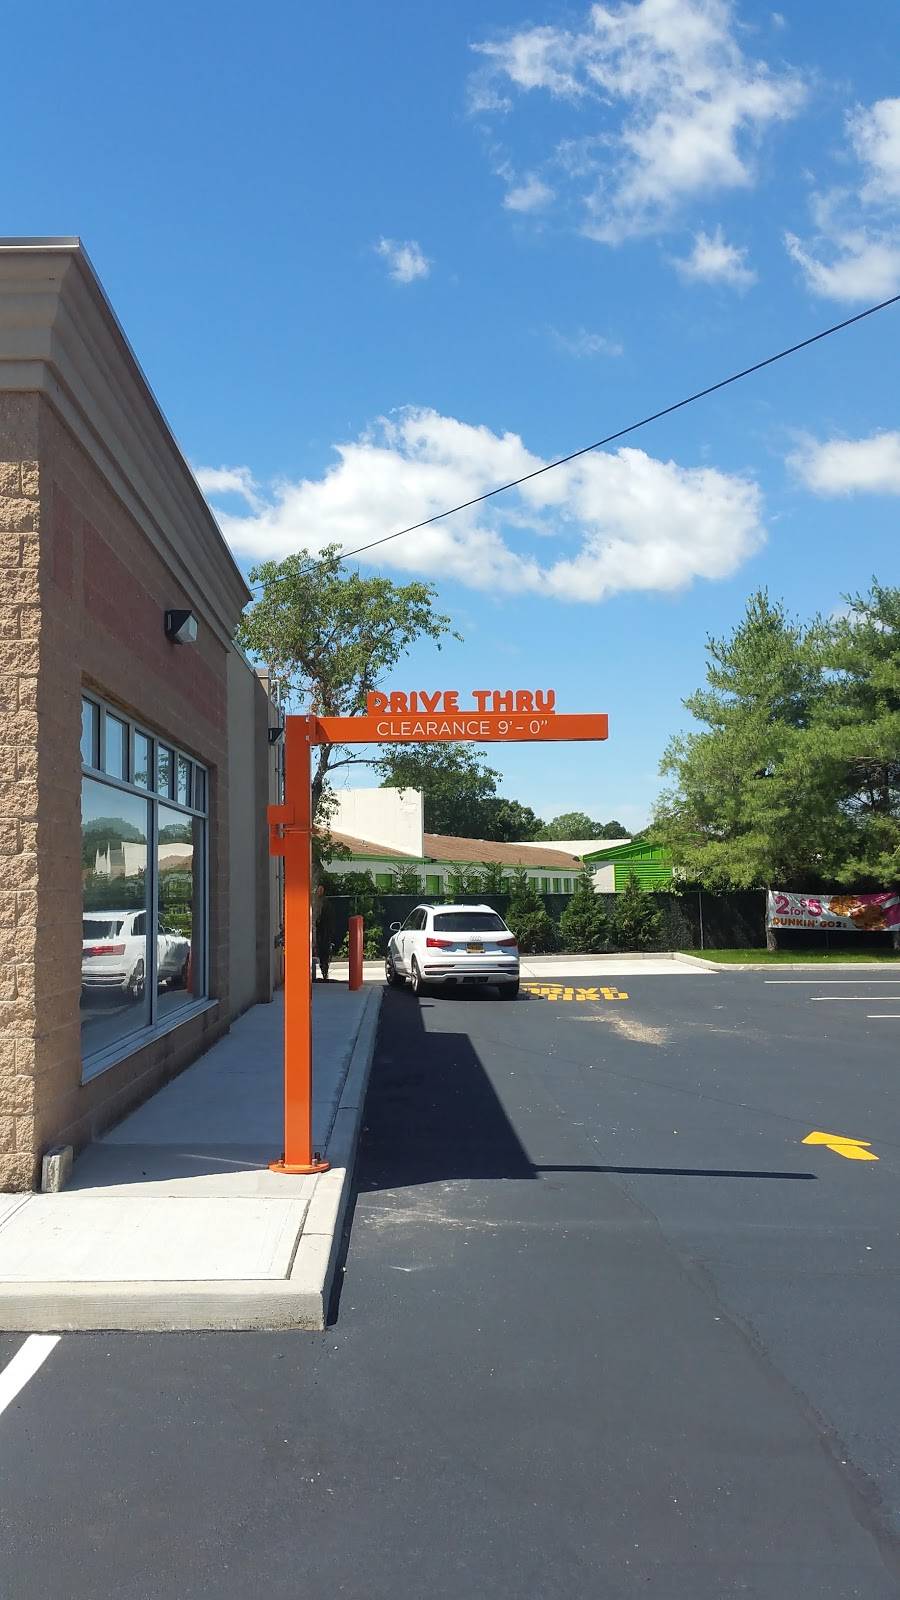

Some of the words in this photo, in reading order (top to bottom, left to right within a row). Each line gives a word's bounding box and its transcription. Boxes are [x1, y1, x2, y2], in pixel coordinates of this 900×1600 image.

[367, 690, 459, 713] DRIVE
[472, 689, 555, 712] THRU
[376, 720, 490, 736] CLEARANCE
[774, 895, 789, 915] 2
[790, 907, 806, 916] for
